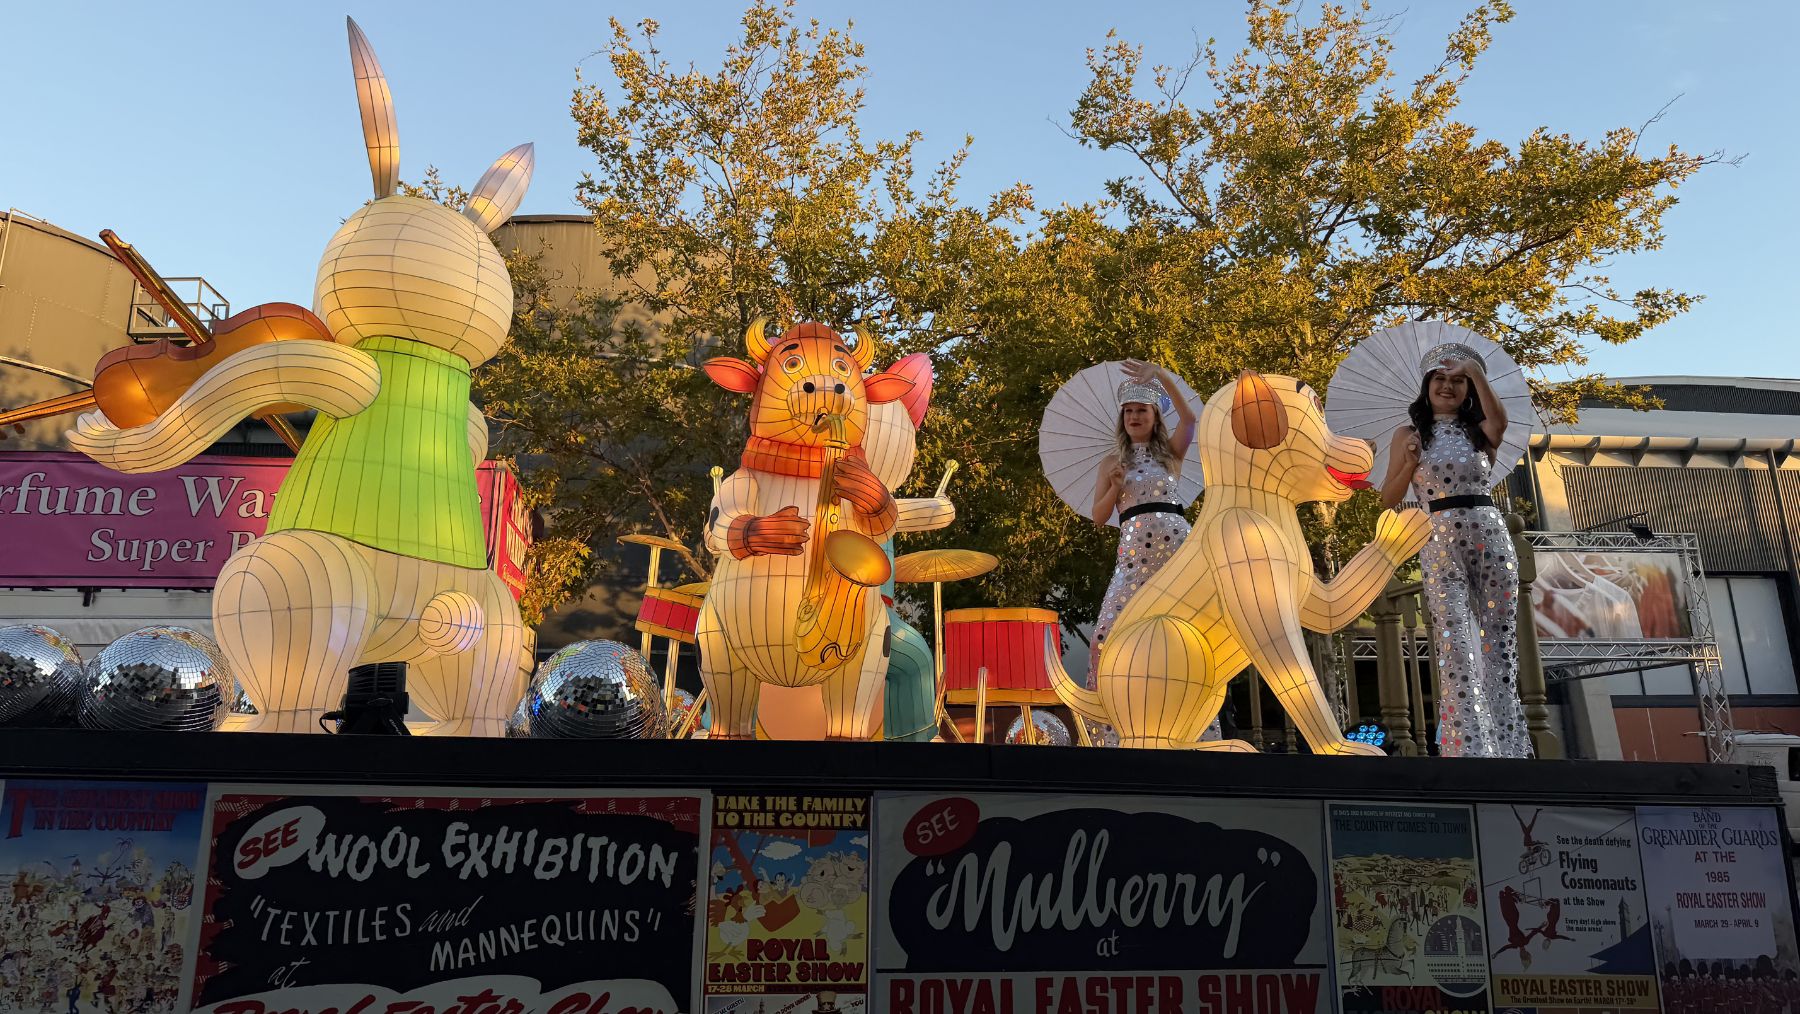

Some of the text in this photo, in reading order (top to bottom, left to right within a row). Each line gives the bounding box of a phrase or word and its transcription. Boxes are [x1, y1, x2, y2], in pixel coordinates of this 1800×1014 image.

[178, 475, 279, 518] Wa
[87, 528, 214, 571] Super
[716, 795, 867, 812] TAKE THE FAMILY
[716, 812, 866, 828] TO THE COUNTRY
[915, 806, 960, 844] SEE
[1335, 819, 1467, 834] THE COUNTRY COMES TO TOWN
[1692, 811, 1721, 823] BAND
[238, 816, 302, 869] SEE
[1556, 835, 1632, 848] See the death defying
[1641, 827, 1778, 849] GRENADIER GUARDS
[307, 821, 679, 888] WOOL EXHIBITION
[1559, 851, 1598, 874] Flying
[1695, 851, 1736, 863] AT THE
[1560, 871, 1637, 891] Cosmonauts
[1705, 871, 1730, 883] 1985
[1563, 896, 1605, 906] at the Show
[1676, 892, 1766, 909] ROYAL EASTER SHOW
[418, 896, 484, 933] and
[1694, 919, 1719, 929] MARCH
[1754, 919, 1760, 928] 9
[746, 938, 830, 961] ROYAL
[1096, 929, 1120, 958] at
[267, 957, 311, 989] at
[708, 961, 864, 983] EASTER SHOW
[733, 985, 765, 993] MARCH
[889, 974, 1320, 1014] ROYAL EASTER SHOW
[1381, 986, 1444, 1010] ROYAL
[1500, 978, 1649, 997] ROYAL EASTER SHOW
